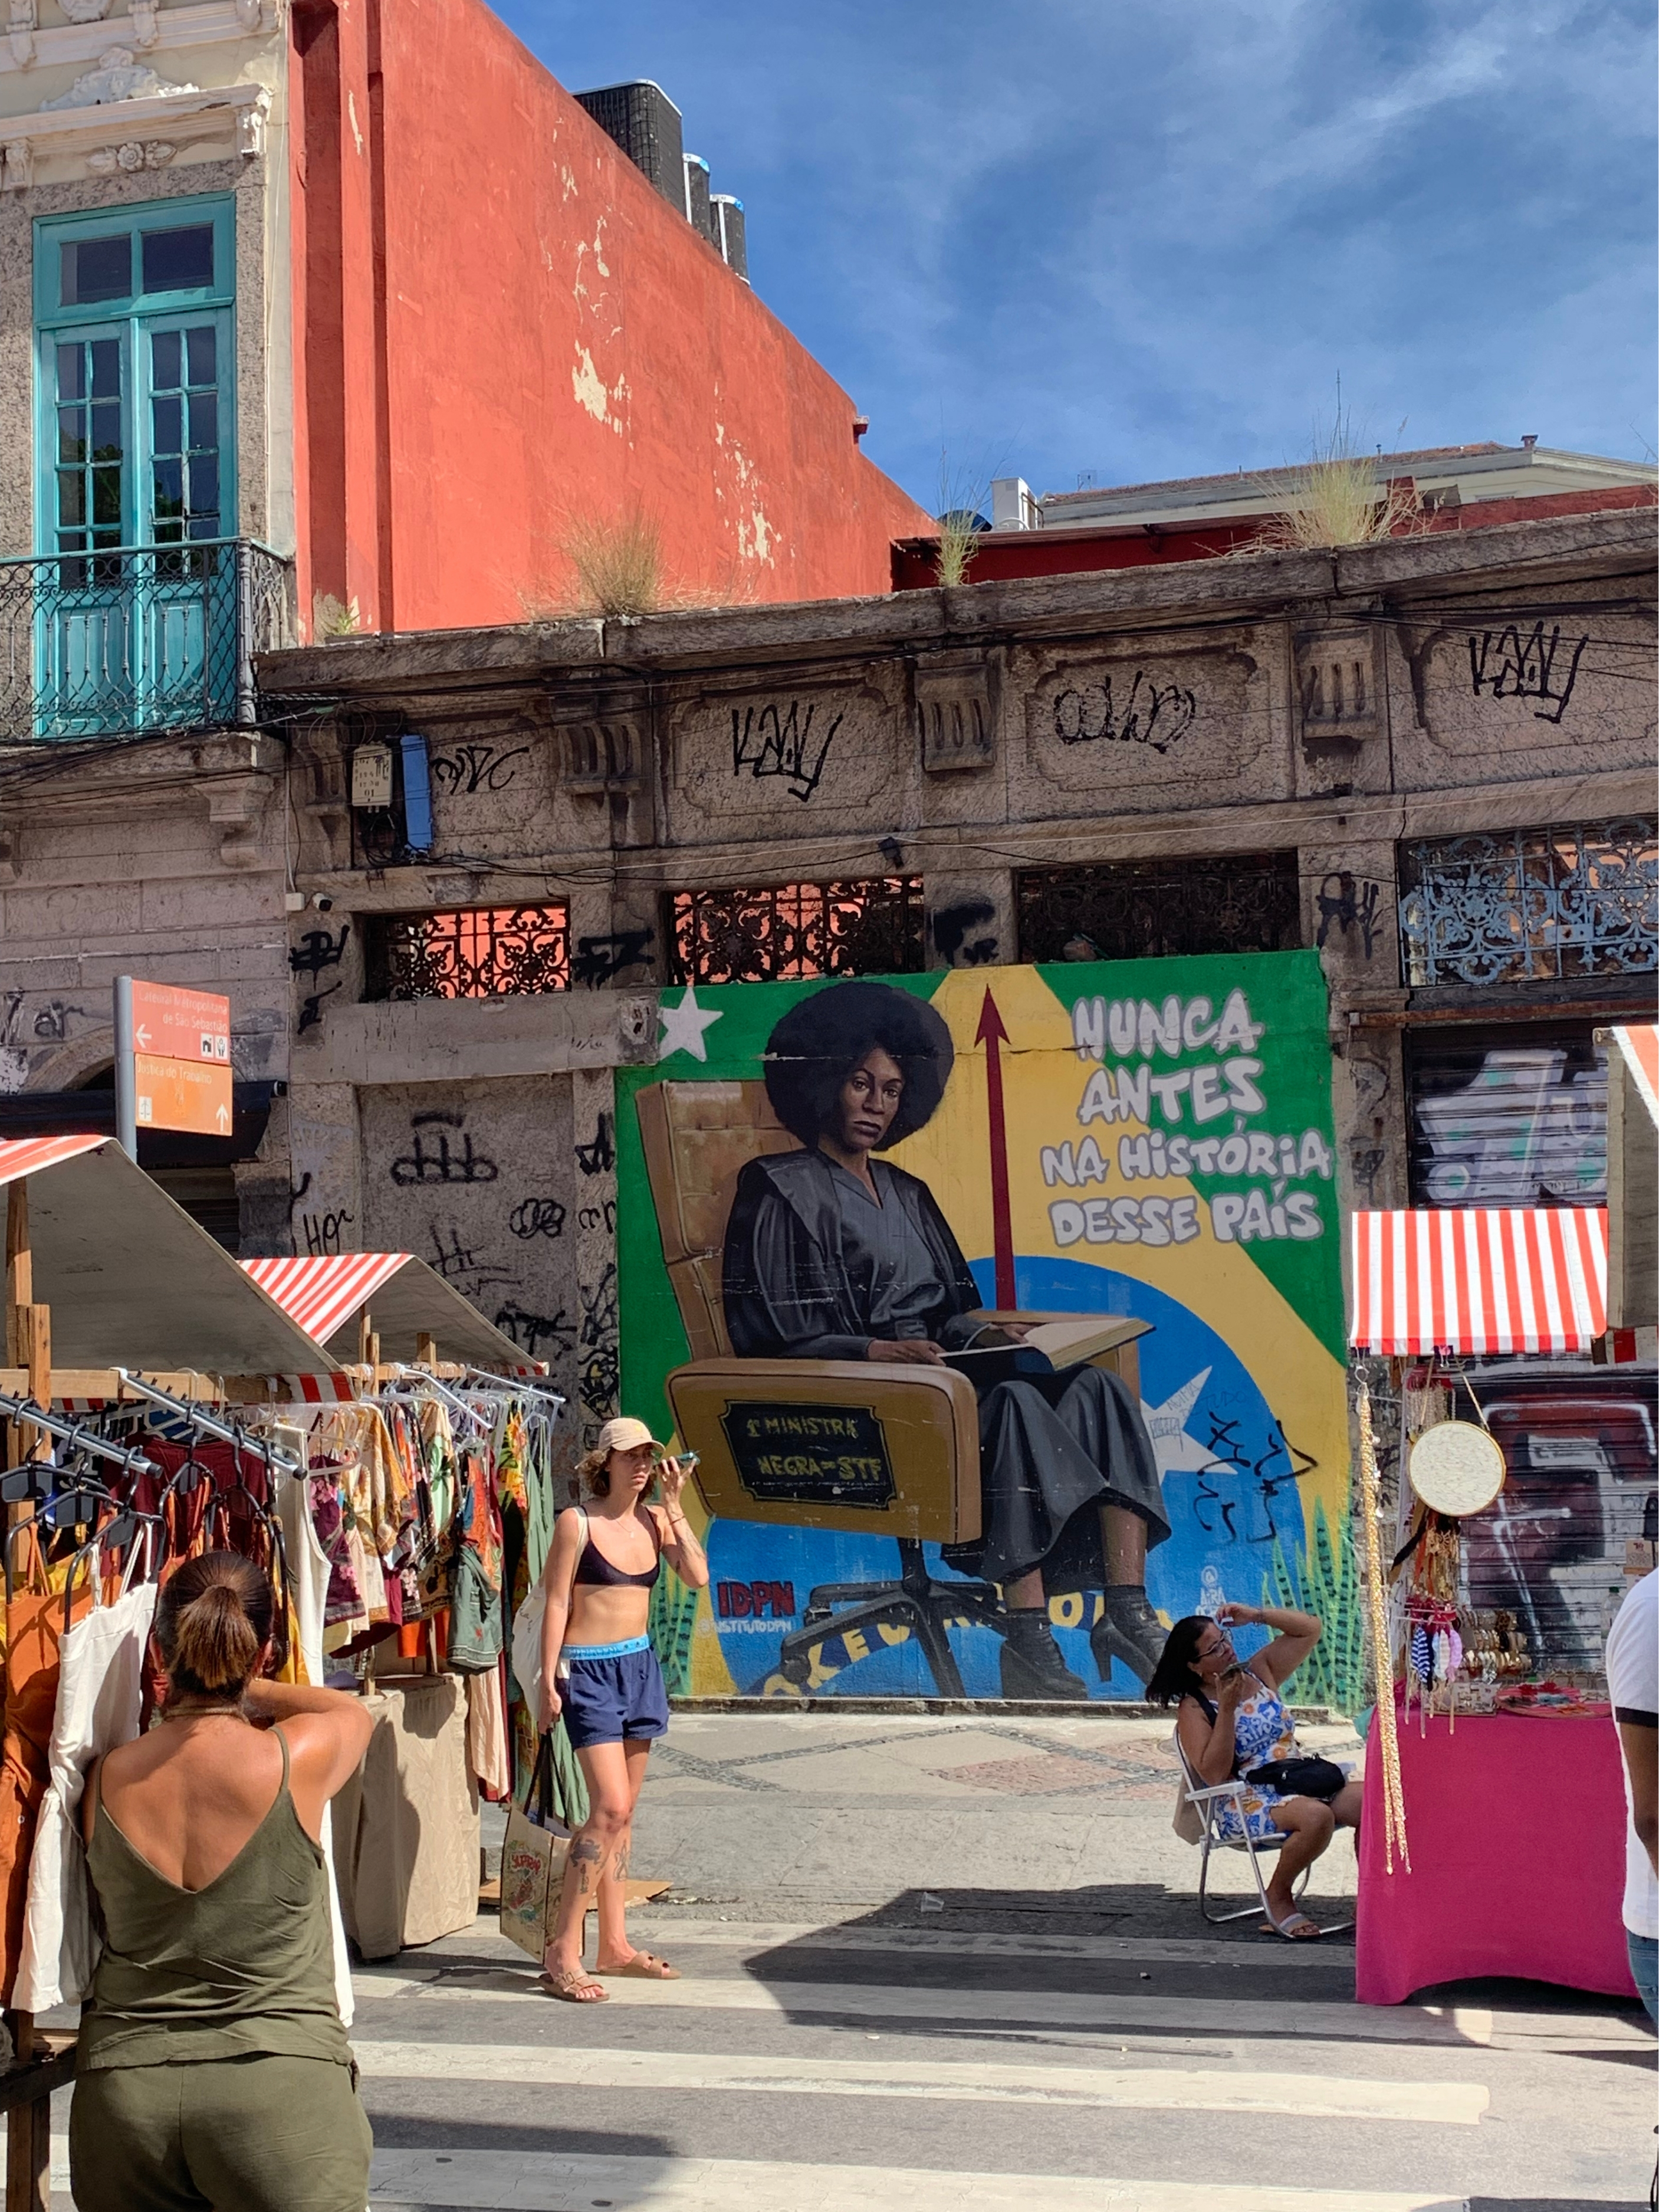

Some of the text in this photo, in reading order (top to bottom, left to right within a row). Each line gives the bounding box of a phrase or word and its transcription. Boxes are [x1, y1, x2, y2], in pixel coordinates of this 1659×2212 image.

[162, 1012, 228, 1033] de São Sebastião
[173, 994, 228, 1016] Metropolitana
[1071, 987, 1264, 1061] NUNCA
[166, 1064, 177, 1079] do
[1077, 1056, 1267, 1125] ANTES
[1040, 1135, 1110, 1187] NA
[1049, 1195, 1201, 1248] DESSE
[717, 1580, 796, 1617] IDPN
